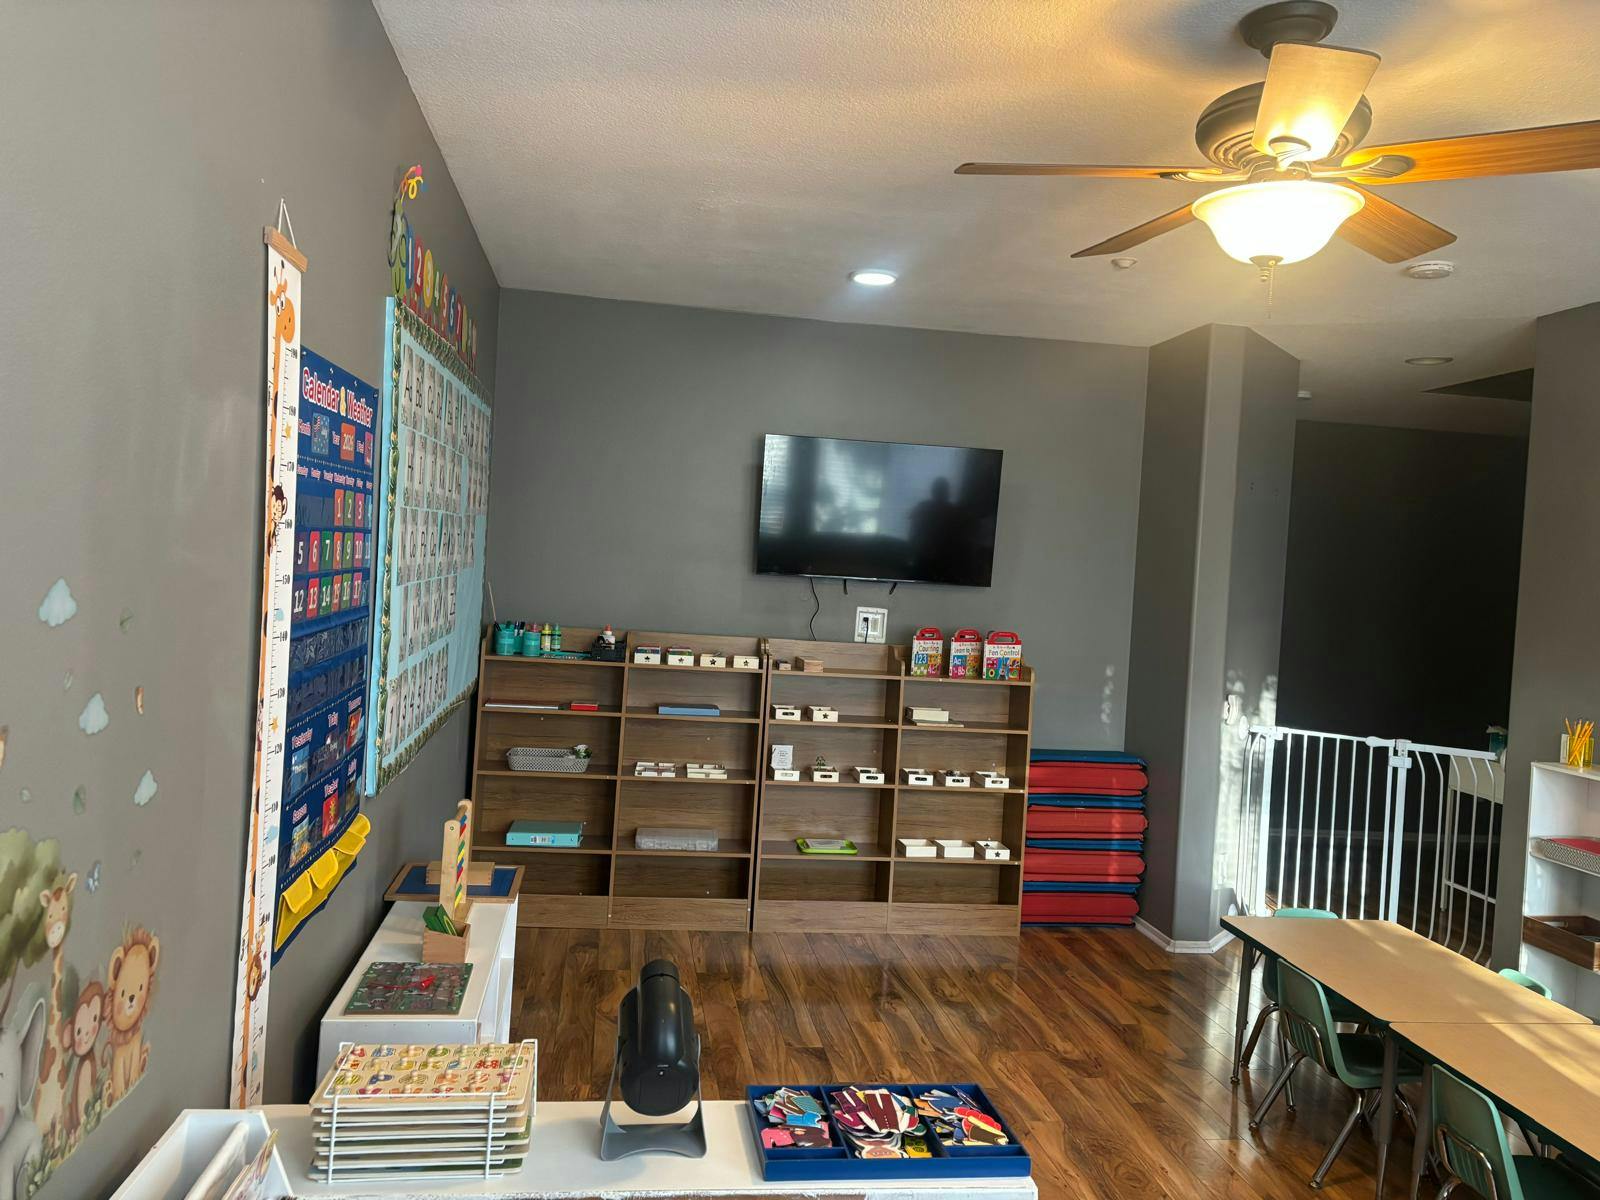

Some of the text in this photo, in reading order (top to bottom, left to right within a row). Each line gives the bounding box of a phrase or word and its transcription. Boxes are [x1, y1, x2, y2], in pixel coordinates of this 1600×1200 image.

[408, 237, 412, 281] 1
[416, 246, 422, 287] 2
[434, 271, 440, 307] 4
[442, 284, 448, 318] 5
[450, 294, 455, 327] 6
[303, 366, 340, 414] Calendar
[340, 386, 347, 417] &
[347, 389, 374, 428] Weather
[337, 498, 341, 518] 1
[347, 499, 352, 519] 2
[358, 502, 362, 520] 3
[297, 541, 304, 565] 5
[312, 540, 318, 563] 6
[325, 539, 331, 561] 7
[336, 540, 341, 561] 8
[346, 541, 351, 560] 9
[355, 541, 363, 560] 10
[282, 574, 290, 586] 150
[294, 589, 304, 614] 12
[309, 587, 318, 610] 13
[321, 584, 331, 607] 14
[343, 581, 351, 601] 16
[353, 580, 361, 600] 17
[279, 630, 287, 642] 140
[919, 645, 940, 654] Counting
[1000, 649, 1020, 658] Control
[915, 654, 928, 665] 123
[277, 686, 285, 698] 130
[274, 743, 282, 755] 120
